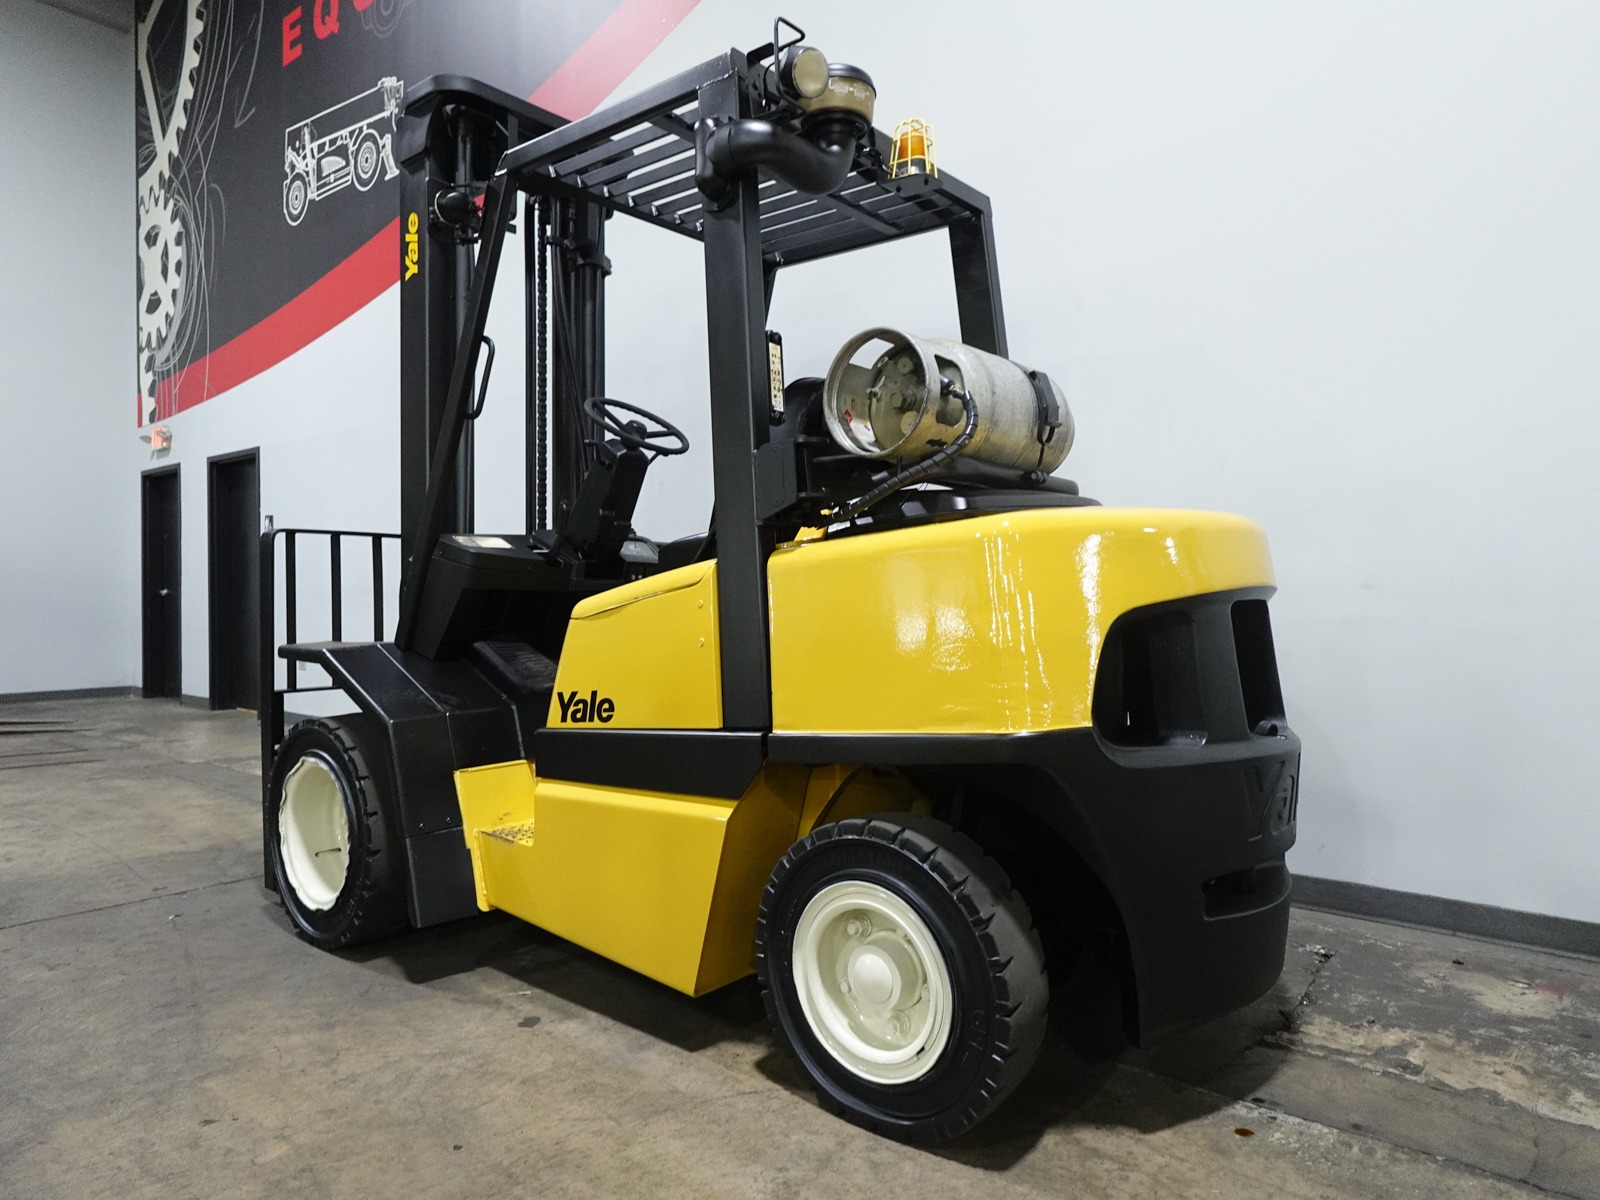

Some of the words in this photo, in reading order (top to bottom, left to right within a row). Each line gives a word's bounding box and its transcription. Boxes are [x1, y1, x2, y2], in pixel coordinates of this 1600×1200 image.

[282, 0, 374, 67] EQ
[405, 212, 418, 281] Yale
[557, 690, 615, 723] Yale
